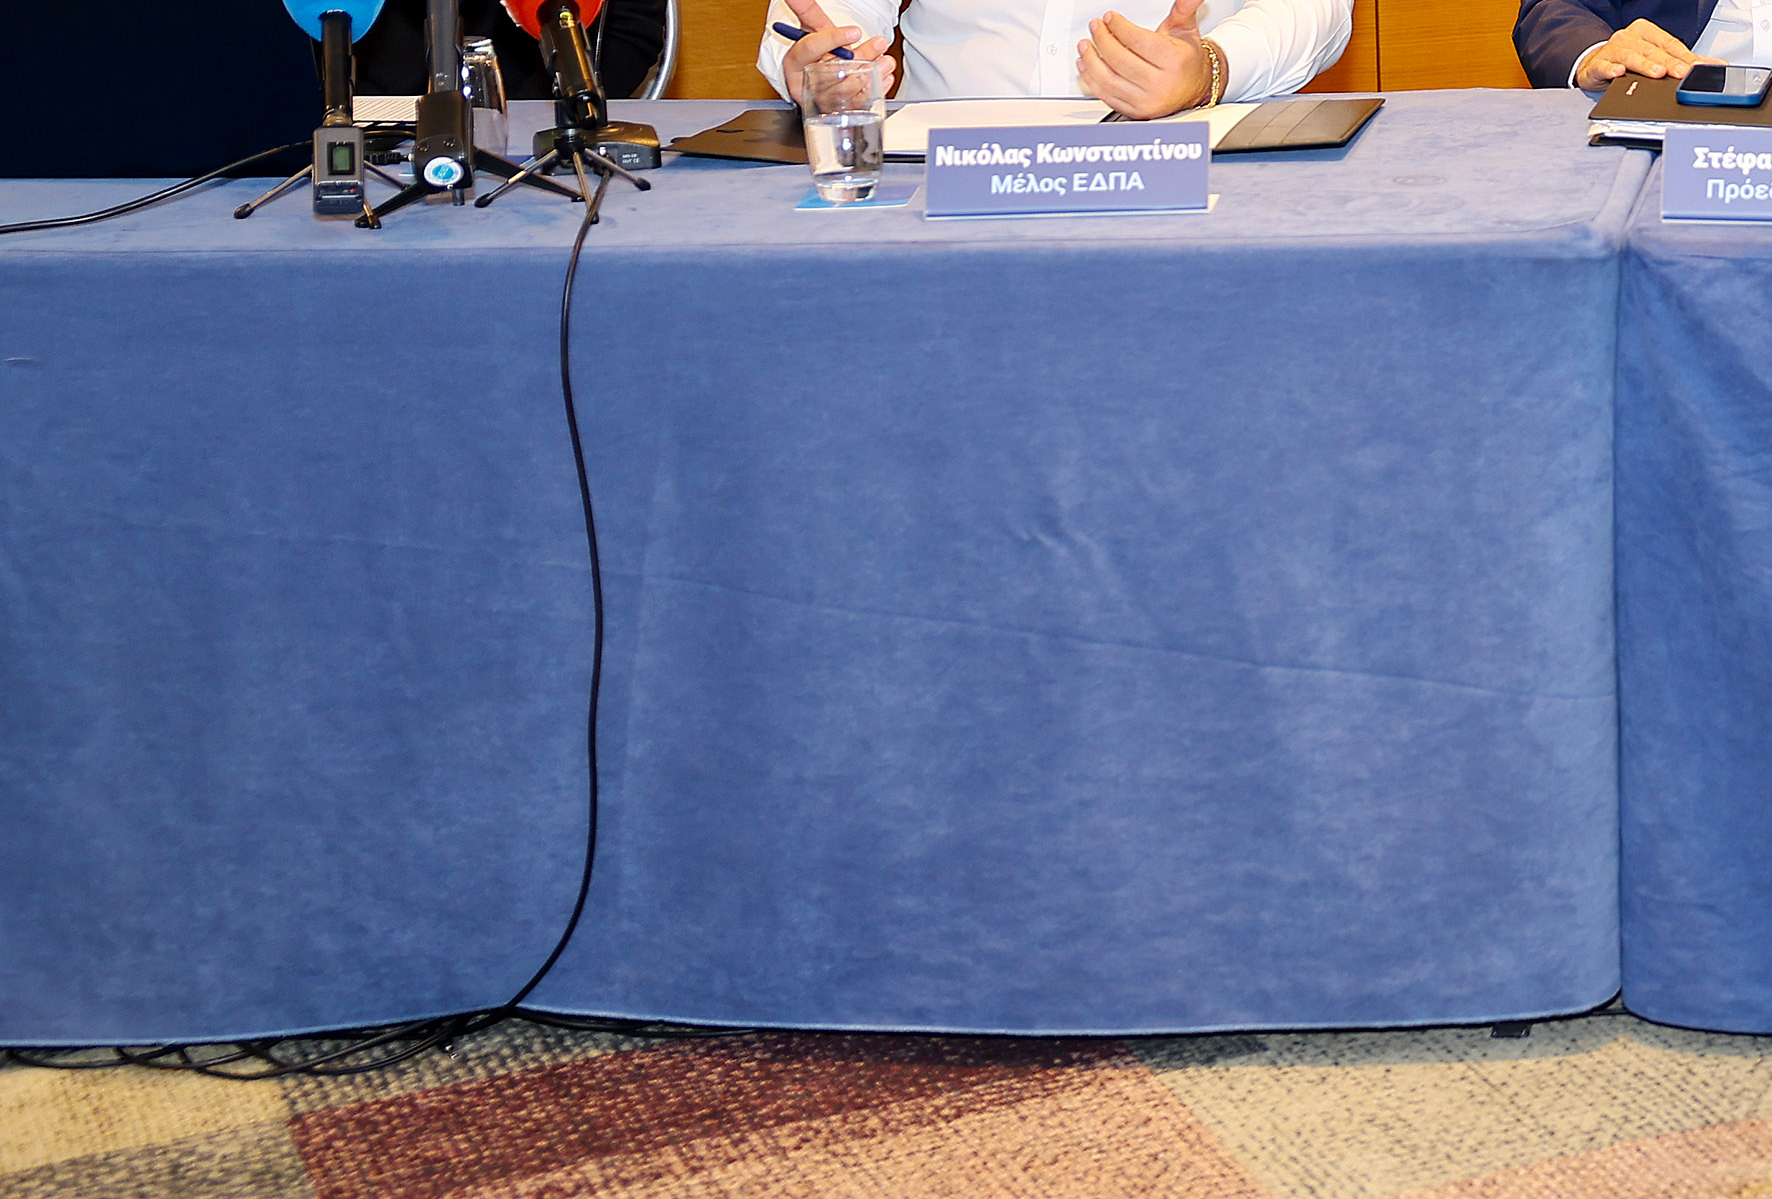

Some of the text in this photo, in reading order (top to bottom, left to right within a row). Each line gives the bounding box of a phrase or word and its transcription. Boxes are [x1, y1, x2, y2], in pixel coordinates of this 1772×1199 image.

[935, 139, 1203, 168] Νικόλας Κωνσταντίνου
[990, 171, 1145, 196] Μέλος ΕΔΠΑ
